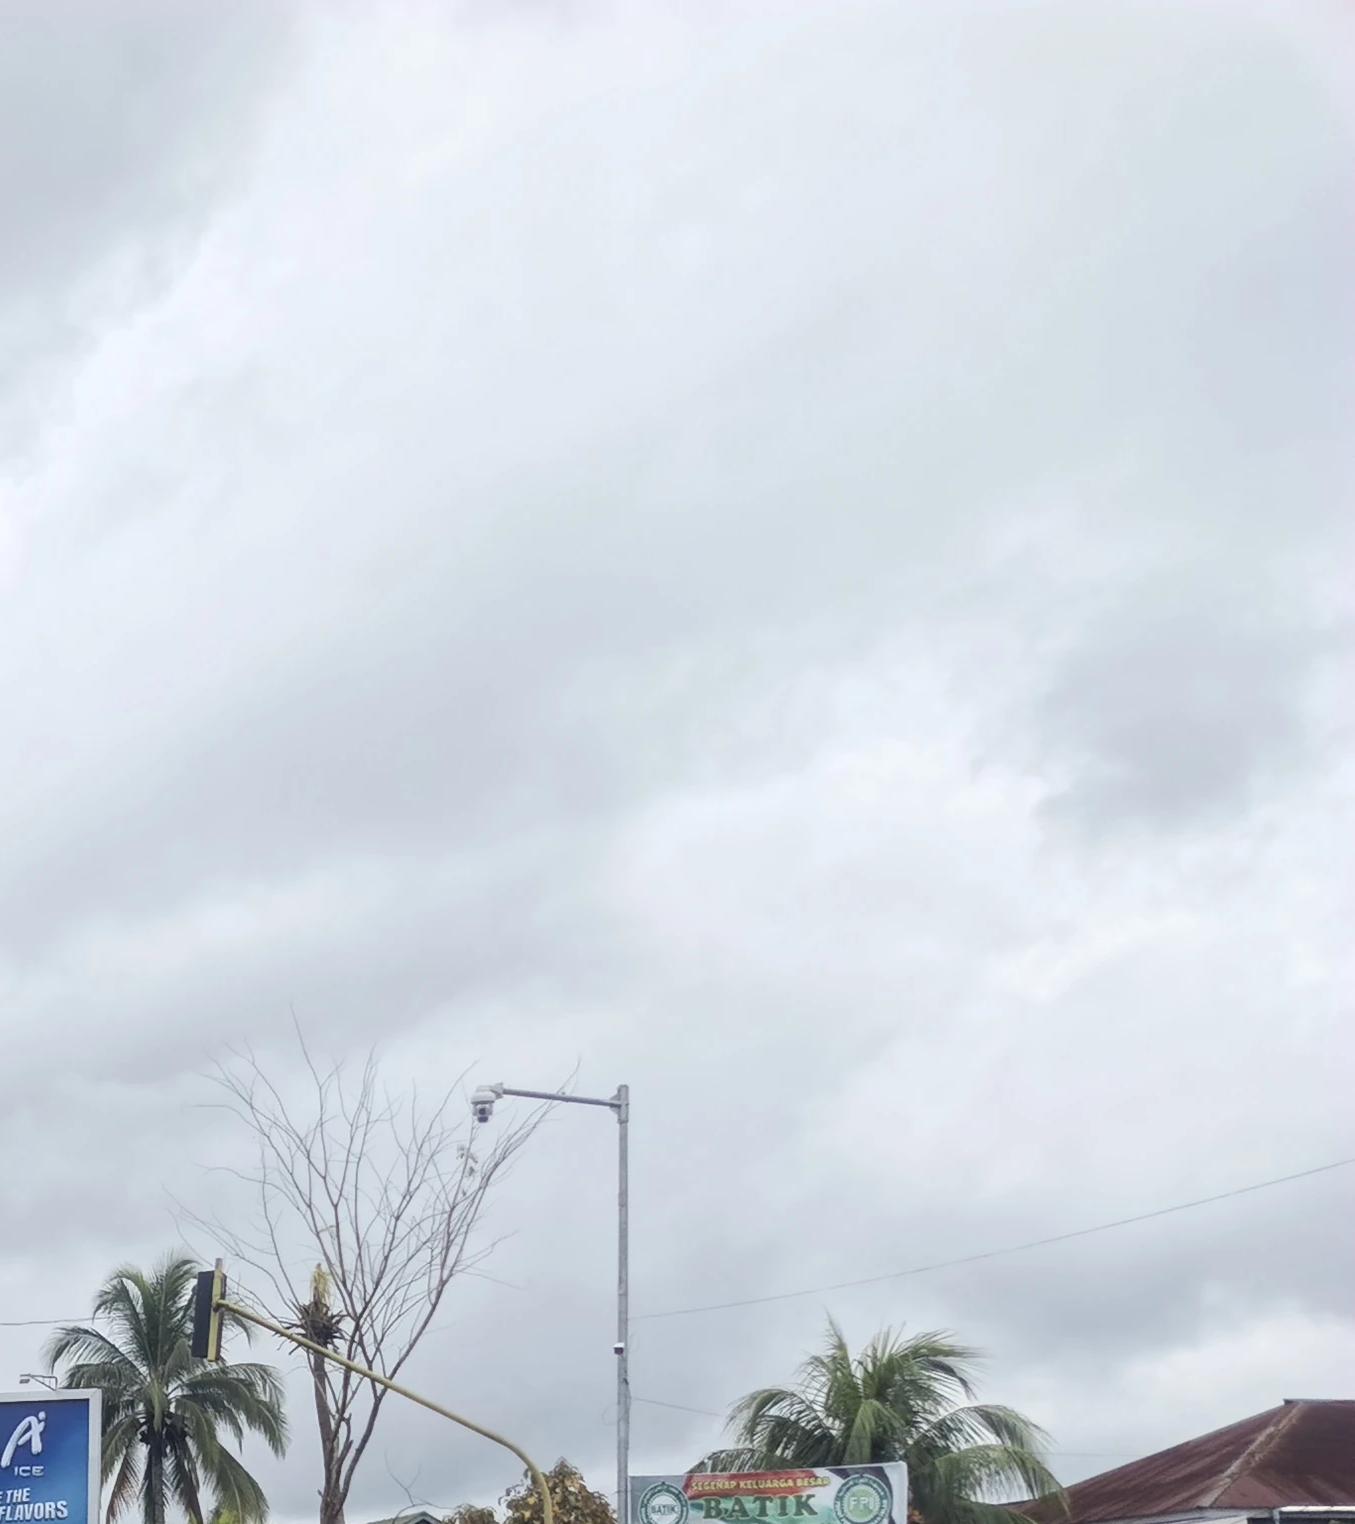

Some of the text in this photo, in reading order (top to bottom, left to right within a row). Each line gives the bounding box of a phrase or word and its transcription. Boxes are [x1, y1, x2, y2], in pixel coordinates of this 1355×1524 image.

[15, 1466, 44, 1476] ICE
[692, 1477, 831, 1492] SEGENAP KELUARGA BESAR
[5, 1488, 31, 1502] THE
[651, 1504, 679, 1516] BATIK
[702, 1493, 818, 1520] BATIK
[848, 1496, 874, 1511] FPI
